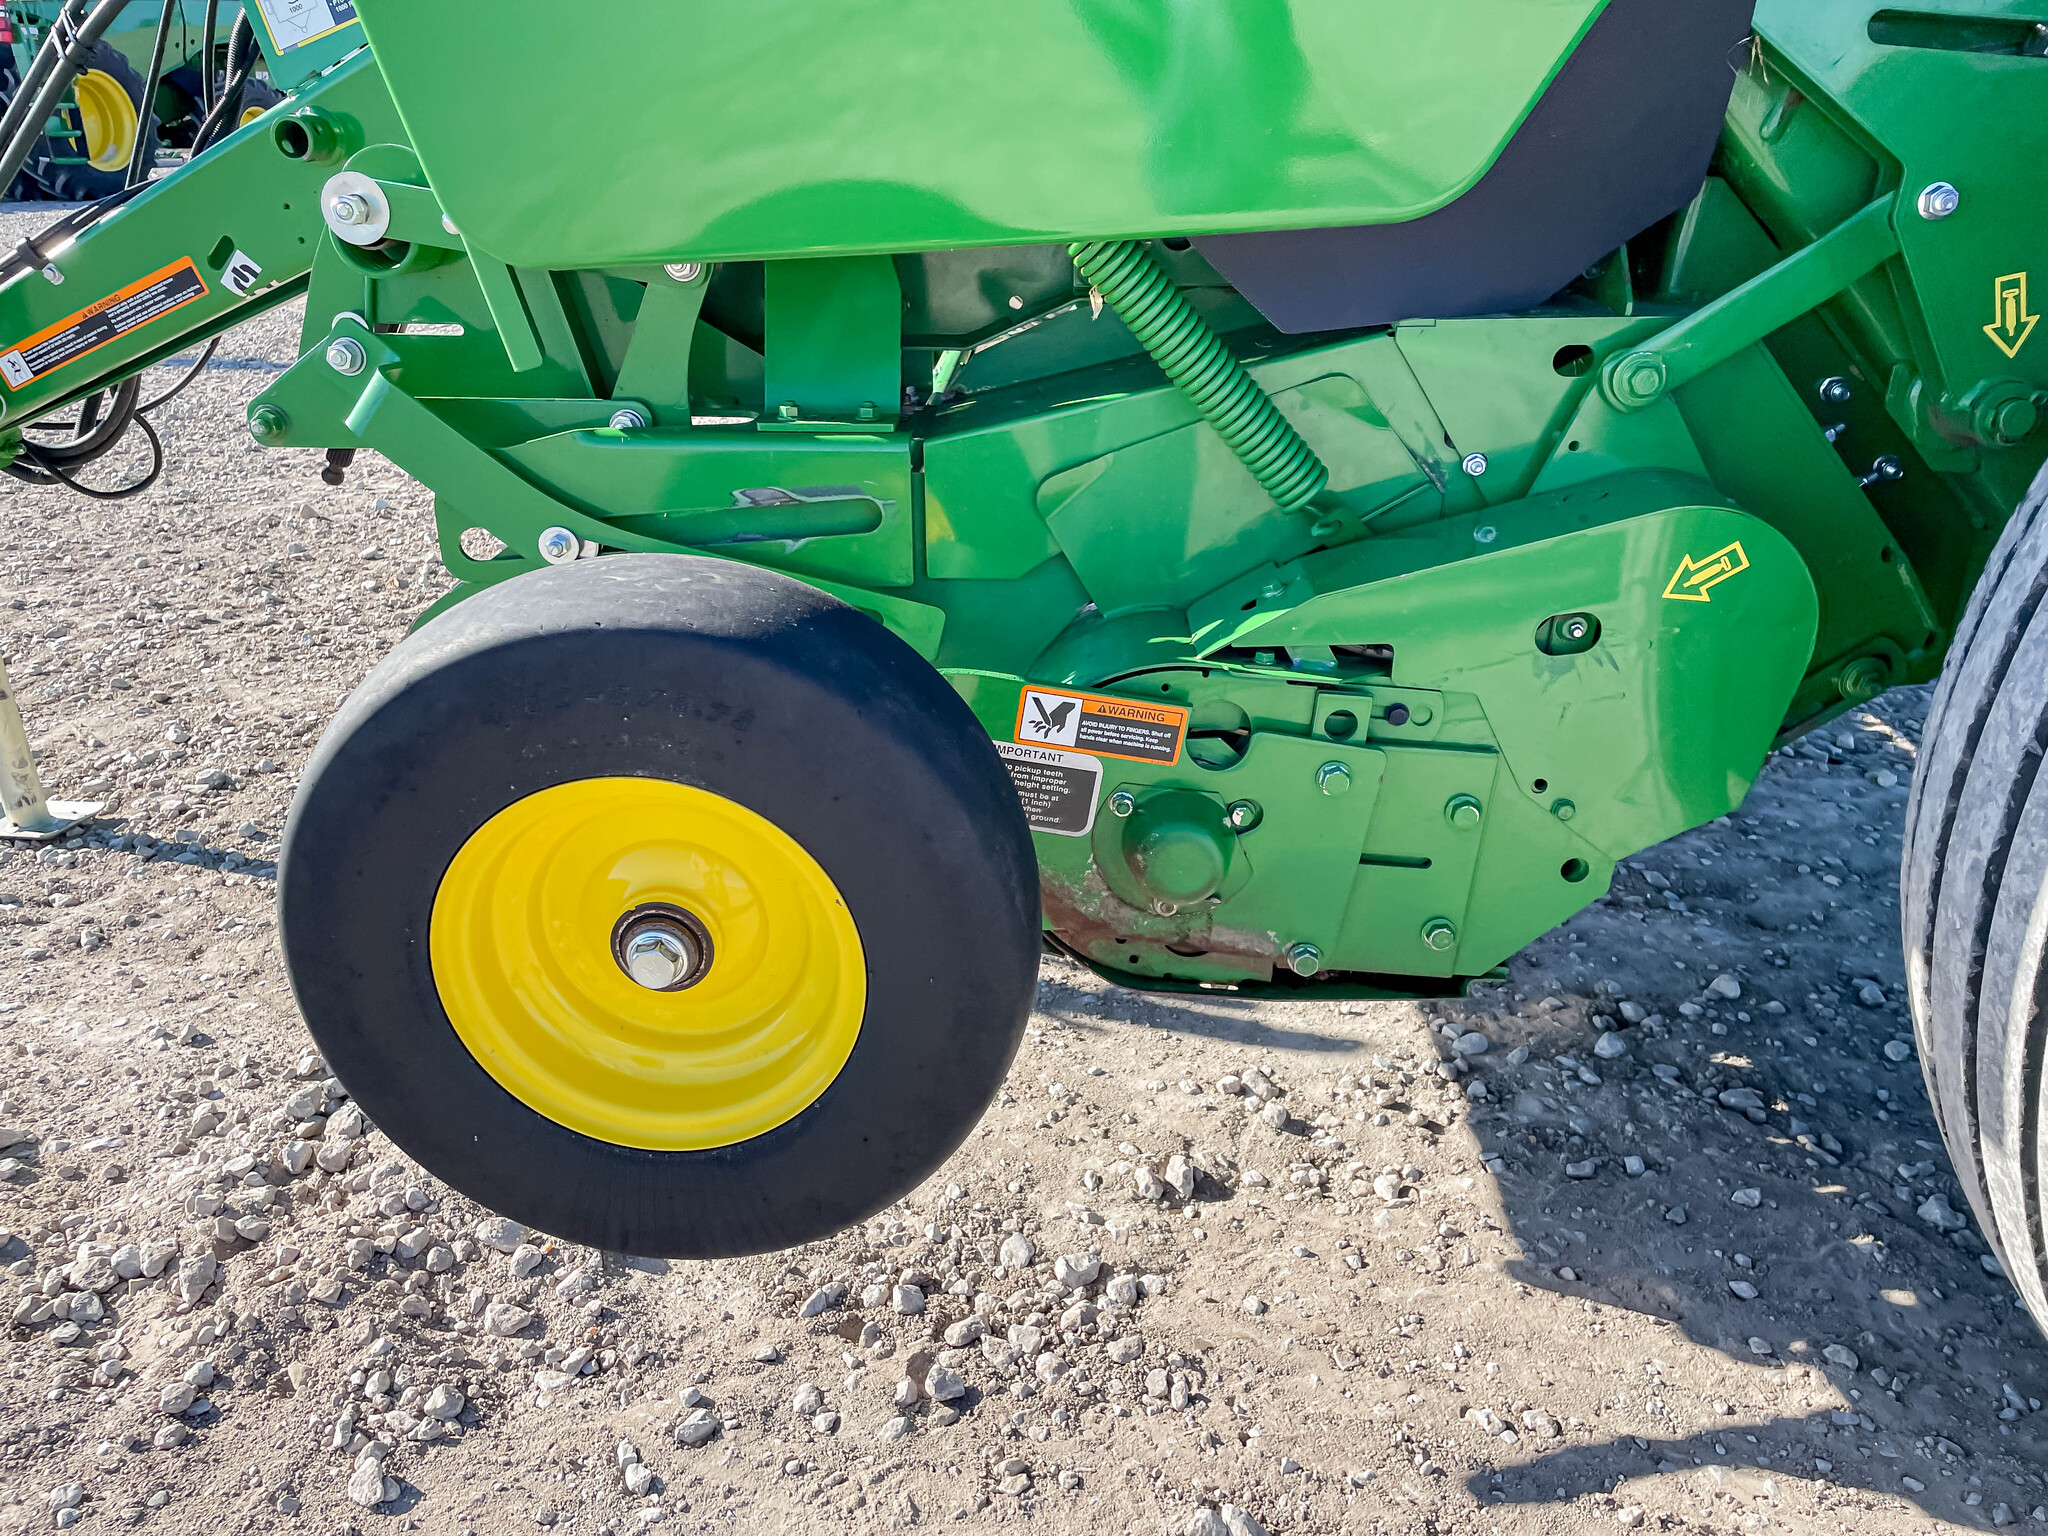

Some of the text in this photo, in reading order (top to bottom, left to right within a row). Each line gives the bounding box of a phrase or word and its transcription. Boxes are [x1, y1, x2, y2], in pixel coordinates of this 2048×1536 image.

[289, 4, 303, 14] 1000
[88, 294, 121, 315] WARNING
[1109, 706, 1164, 722] WARNING
[1126, 727, 1150, 735] FINGERS.
[1121, 733, 1144, 742] servicing.
[1123, 740, 1144, 748] machine
[1151, 744, 1171, 753] running.
[997, 744, 1064, 763] MPORTANT
[1015, 765, 1041, 775] pickup
[1044, 769, 1063, 777] teeth
[1031, 773, 1067, 785] improper
[1015, 780, 1071, 794] height setting.
[1018, 790, 1037, 798] must
[1040, 792, 1049, 800] be
[1031, 799, 1051, 808] inch)
[1031, 814, 1060, 823] ground.
